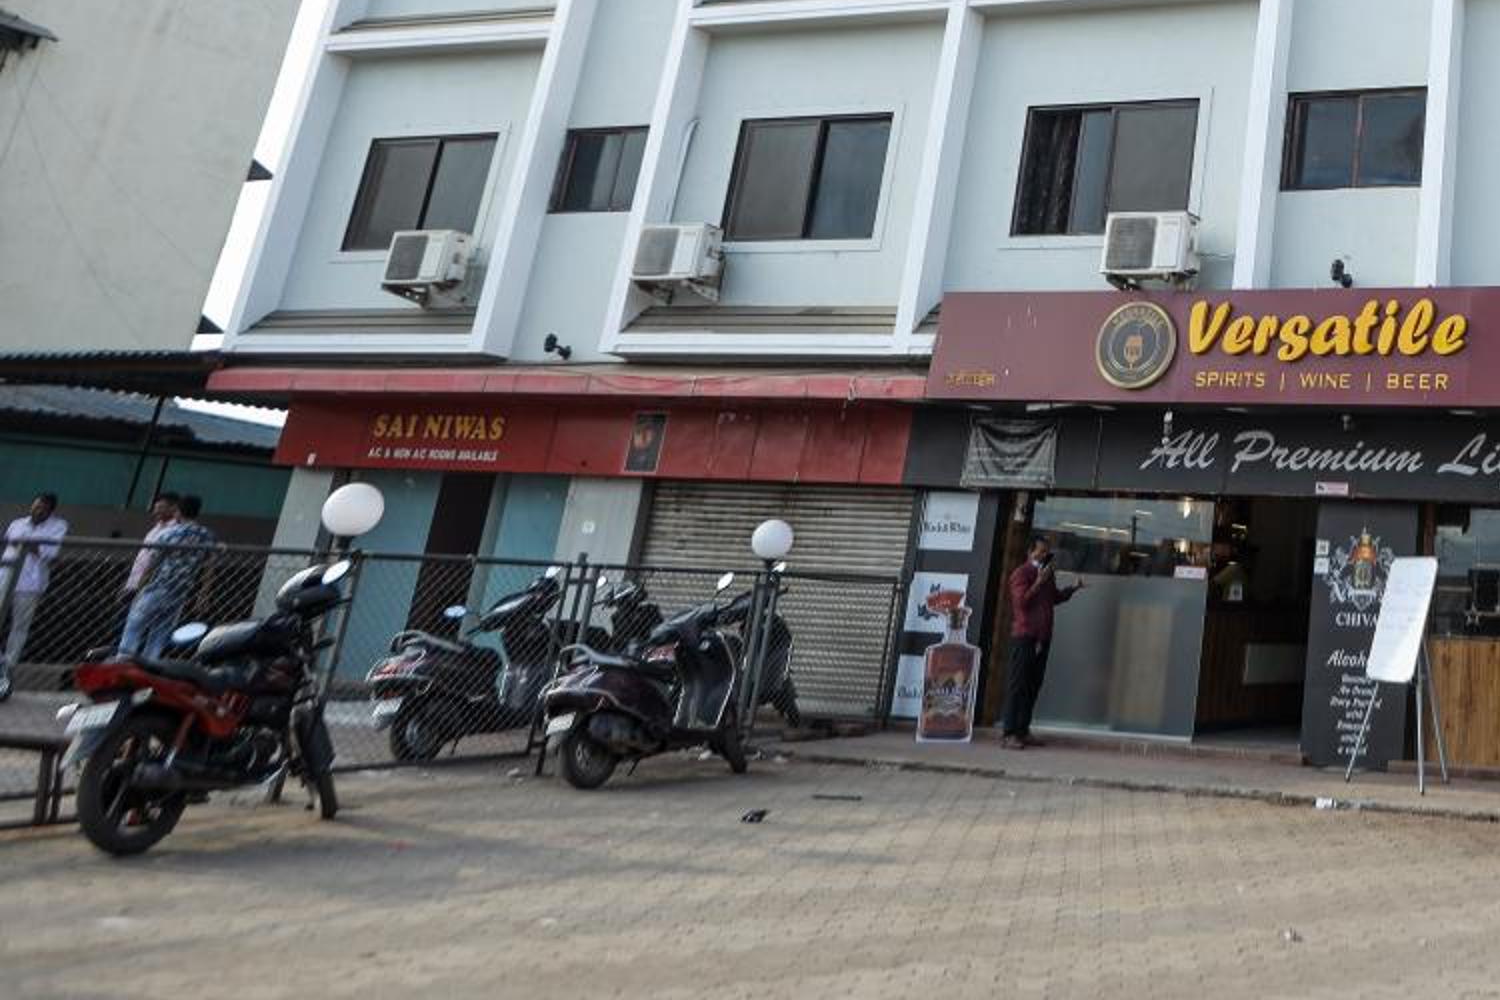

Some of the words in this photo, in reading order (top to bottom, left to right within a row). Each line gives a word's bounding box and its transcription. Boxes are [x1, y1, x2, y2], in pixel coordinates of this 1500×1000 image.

[1188, 298, 1470, 362] Versatile
[1194, 371, 1267, 389] SPIRITS
[1300, 373, 1352, 390] WINE
[1386, 373, 1449, 391] BEER
[373, 414, 418, 438] SAI
[423, 415, 505, 440] NIWAS
[1141, 430, 1220, 471] All
[1231, 430, 1424, 473] Premium
[1335, 611, 1378, 628] CHIVA
